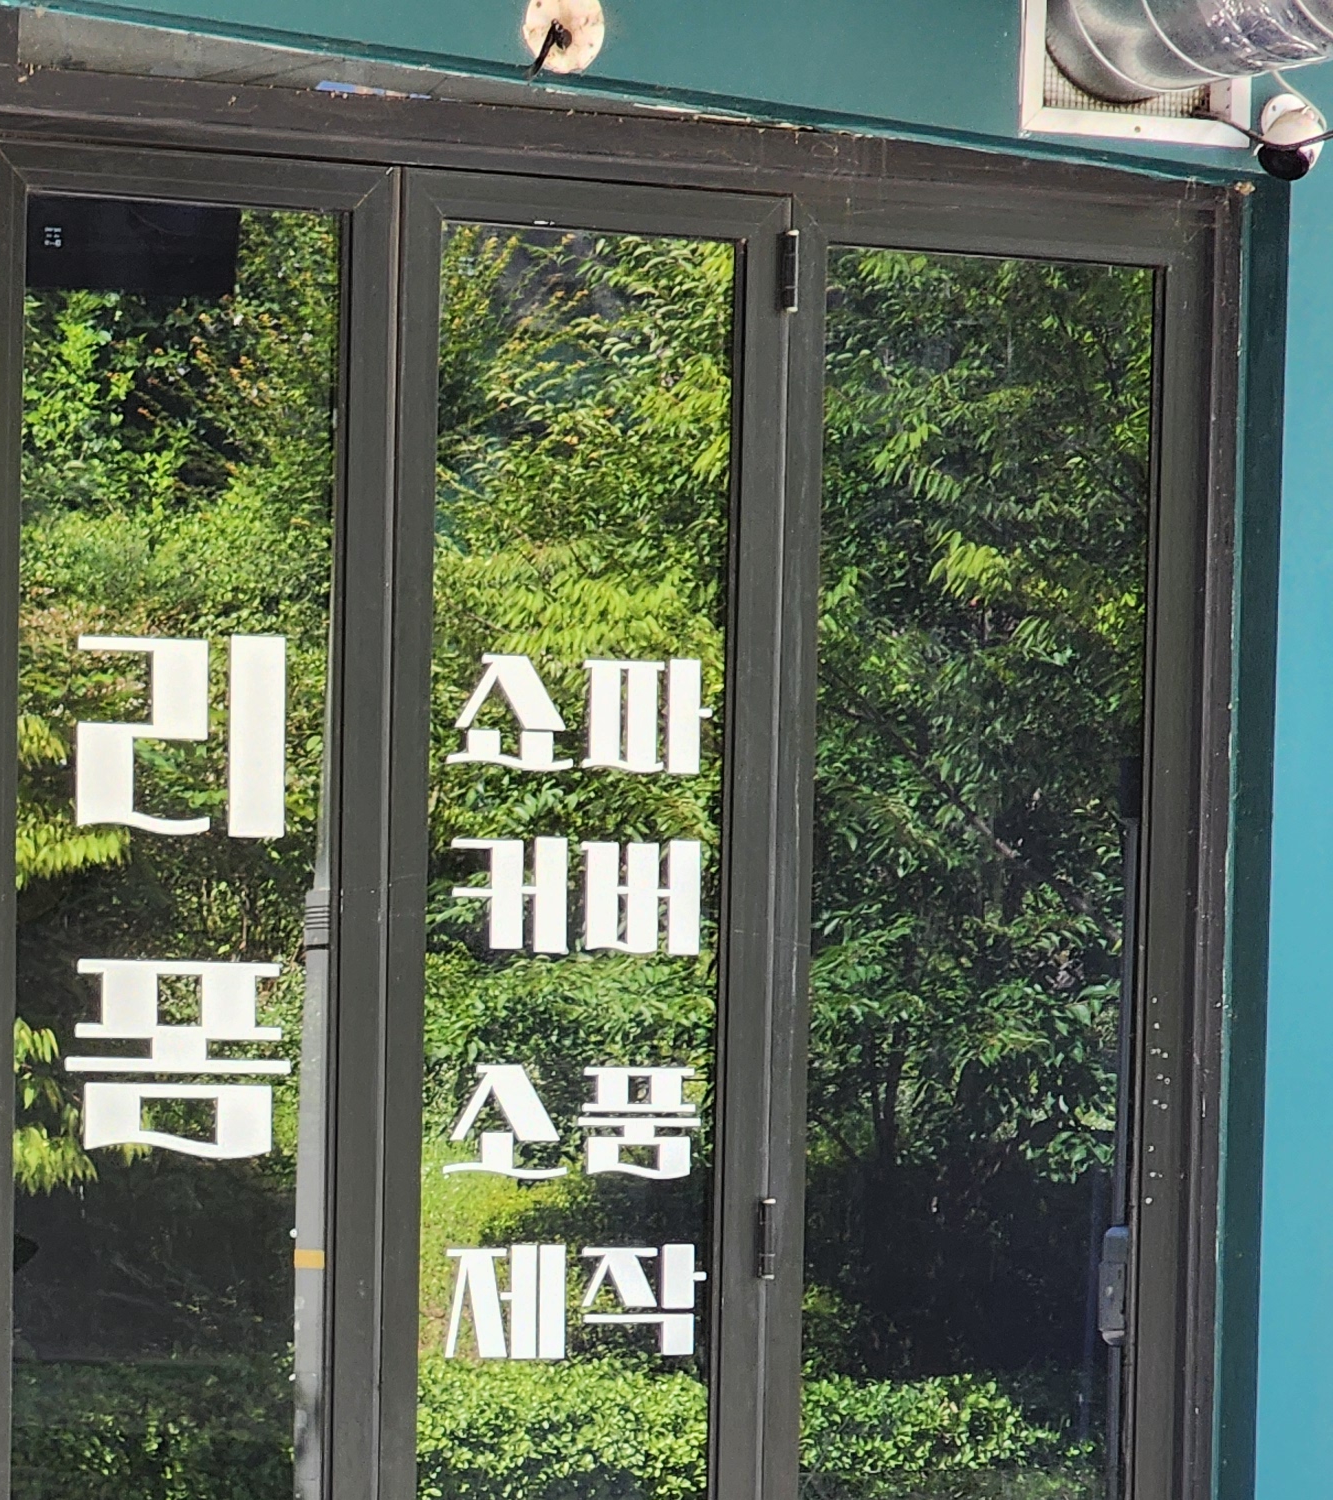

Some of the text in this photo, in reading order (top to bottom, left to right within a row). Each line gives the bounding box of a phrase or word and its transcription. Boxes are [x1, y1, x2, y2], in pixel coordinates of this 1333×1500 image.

[446, 653, 713, 775] 소파
[65, 634, 292, 1160] 리폼
[450, 836, 701, 956] 커버
[442, 1064, 700, 1180] 소품
[444, 1244, 707, 1360] 제작
